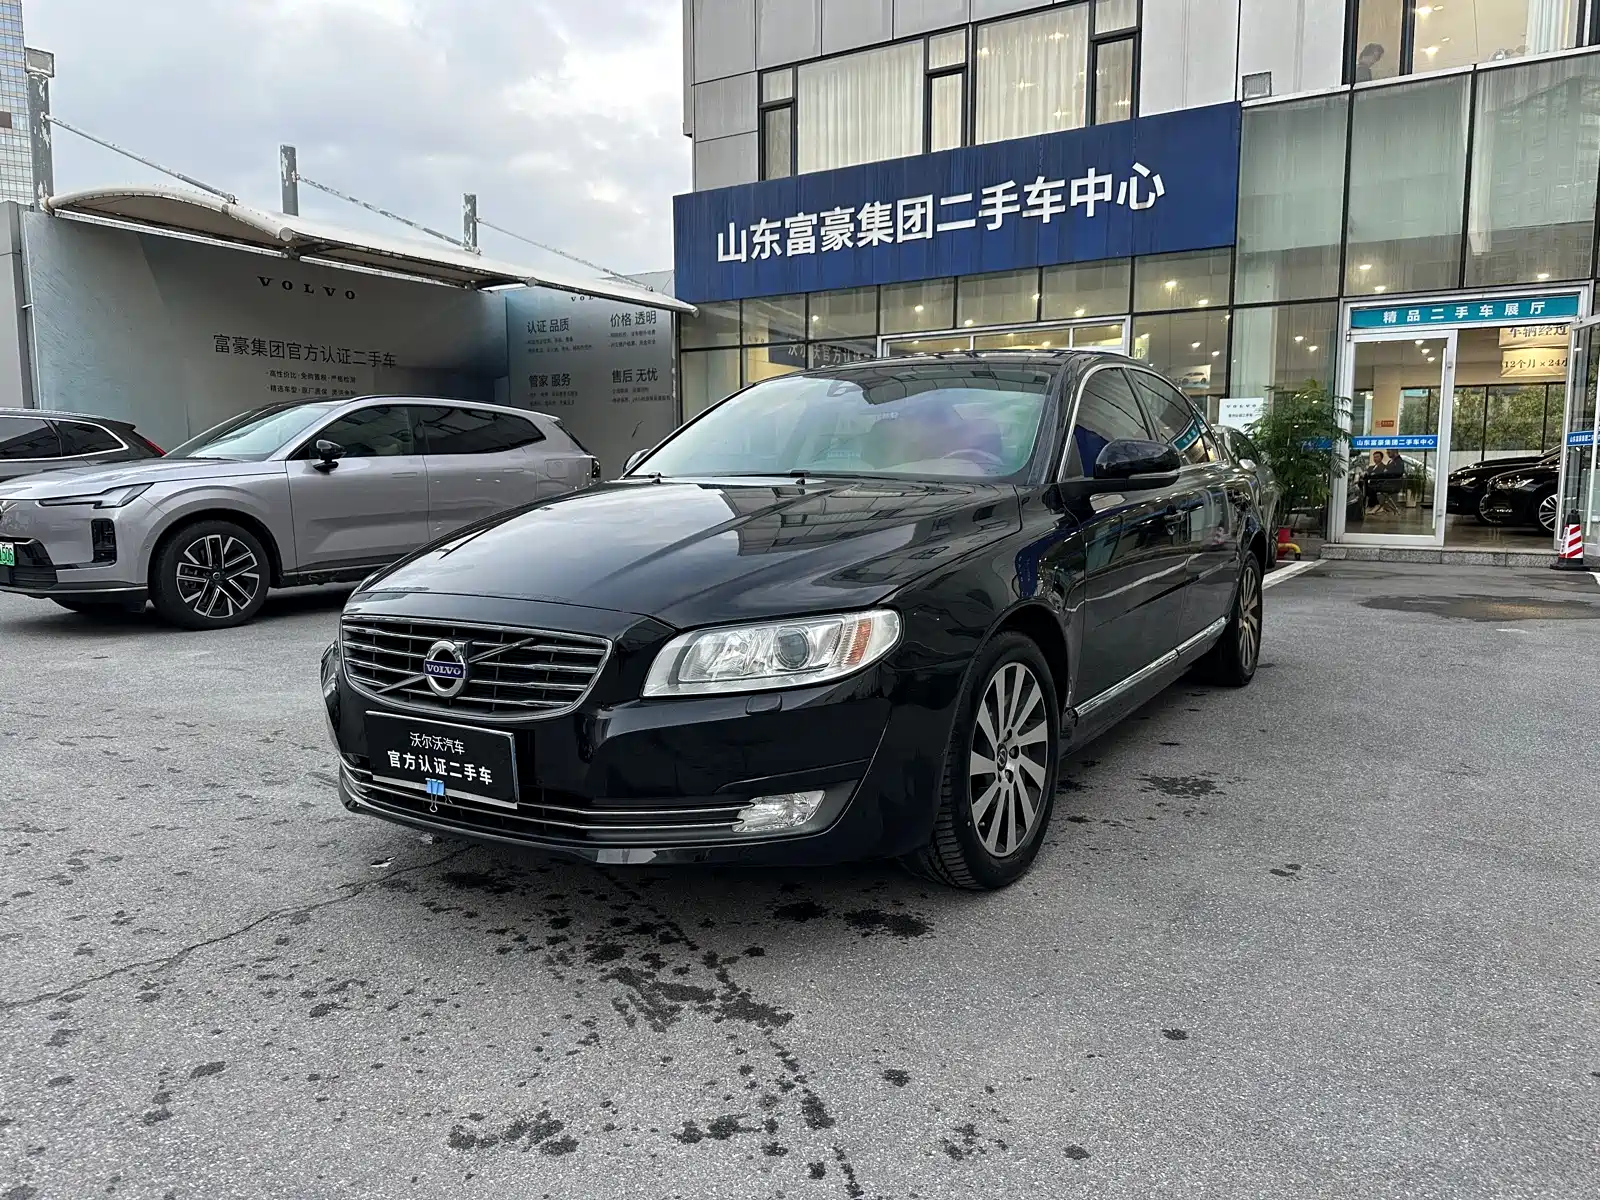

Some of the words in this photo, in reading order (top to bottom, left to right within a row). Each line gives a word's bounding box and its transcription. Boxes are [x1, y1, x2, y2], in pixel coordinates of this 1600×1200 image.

[717, 162, 1165, 264] 山东富豪集团二手车中心
[257, 276, 356, 300] VOLVO
[610, 313, 632, 328] 价格
[635, 310, 657, 325] 透明
[1383, 301, 1546, 323] 精品二手车展厅
[527, 319, 547, 334] 认证
[549, 317, 570, 333] 品质
[213, 334, 397, 369] 富豪集团官方认证二手车
[529, 374, 549, 388] 管家
[551, 373, 572, 387] 服务
[612, 370, 633, 384] 售后
[636, 367, 659, 382] 无忧
[426, 663, 461, 676] VOLVO
[409, 731, 465, 755] 沃尔沃汽车
[388, 750, 493, 785] 官方认证二手车
